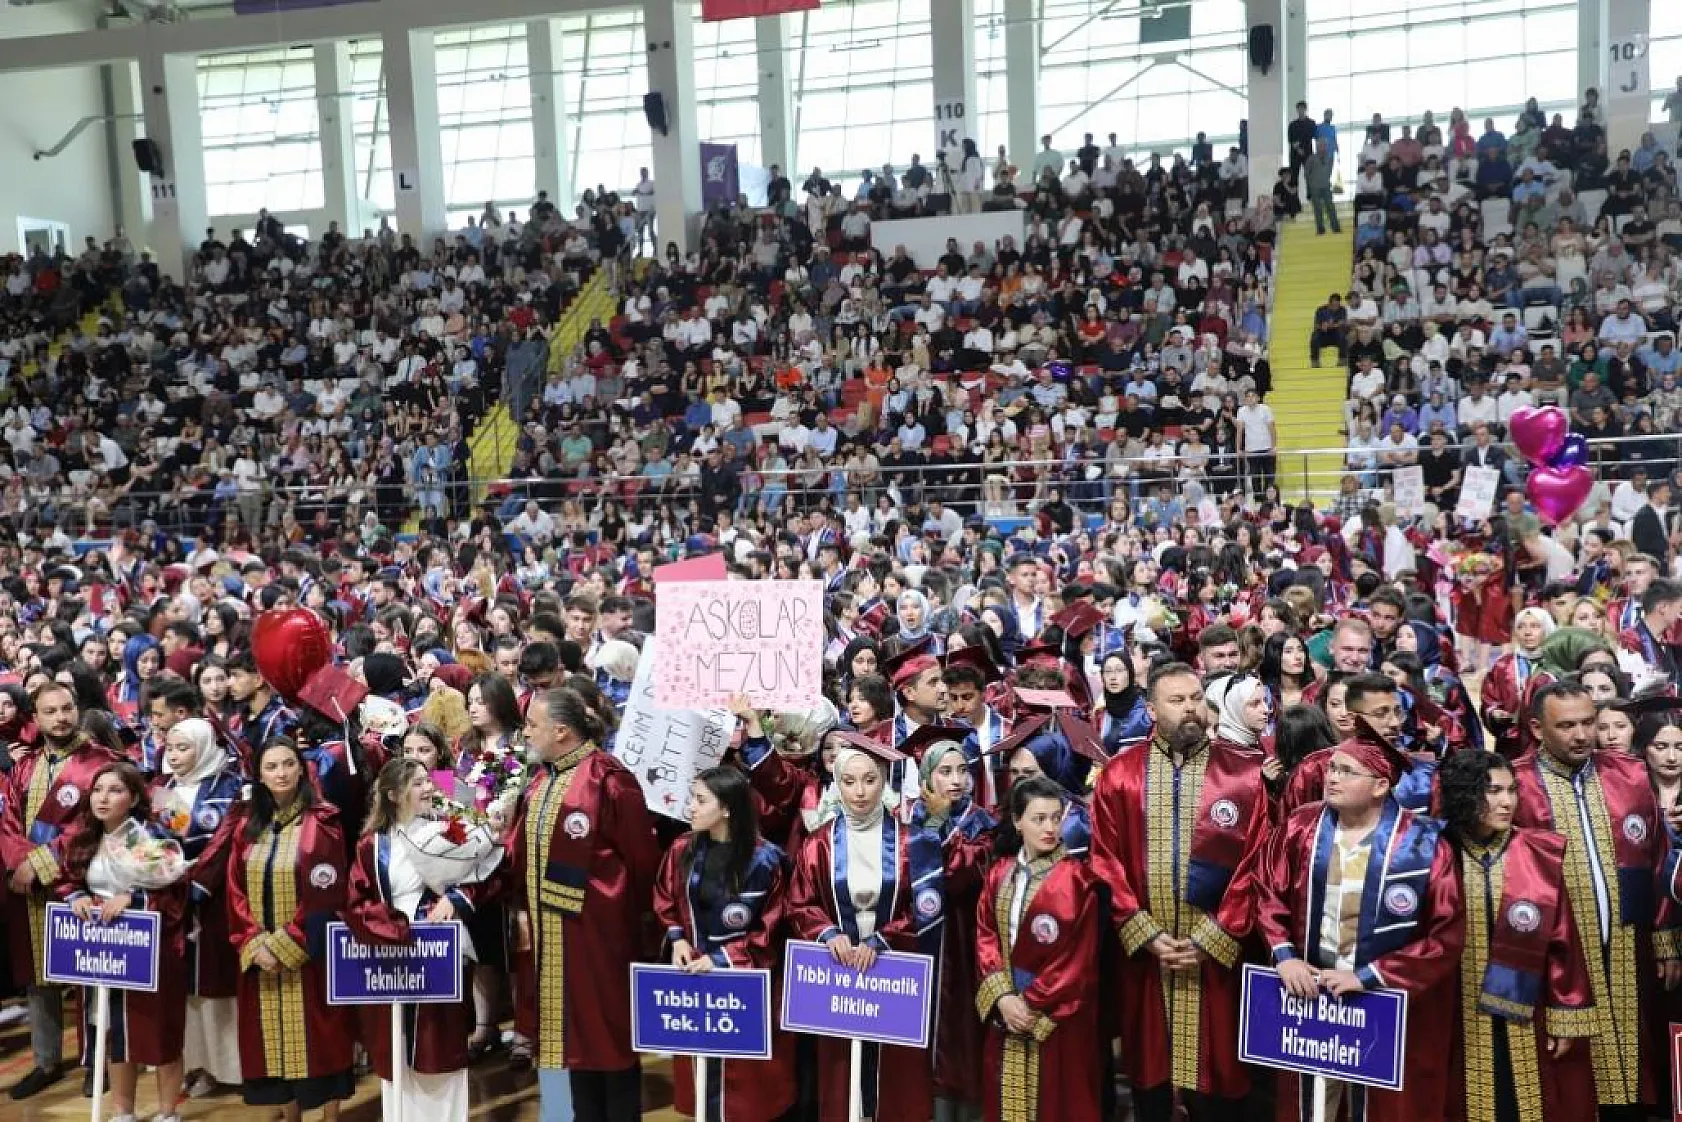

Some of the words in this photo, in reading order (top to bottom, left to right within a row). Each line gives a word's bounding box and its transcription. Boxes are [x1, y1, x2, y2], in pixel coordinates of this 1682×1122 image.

[1620, 71, 1638, 92] J
[935, 102, 965, 120] 110
[940, 129, 958, 148] K
[151, 183, 176, 199] 111
[400, 172, 413, 190] L
[696, 648, 800, 693] MEZUN
[54, 915, 80, 941] Tıbbi
[75, 948, 127, 976] Teknikleri
[365, 964, 426, 991] Teknikleri
[796, 964, 831, 986] Tıbbi
[835, 972, 852, 989] ve
[855, 971, 919, 997] Aromatik
[652, 990, 700, 1009] Tıbbi
[705, 992, 747, 1010] Lab.
[830, 995, 880, 1018] Bitkiler
[1317, 993, 1367, 1029] Bakım
[661, 1013, 700, 1031] Tek.
[704, 1011, 740, 1033] İ.Ö.
[1281, 1026, 1361, 1067] Hizmetleri
